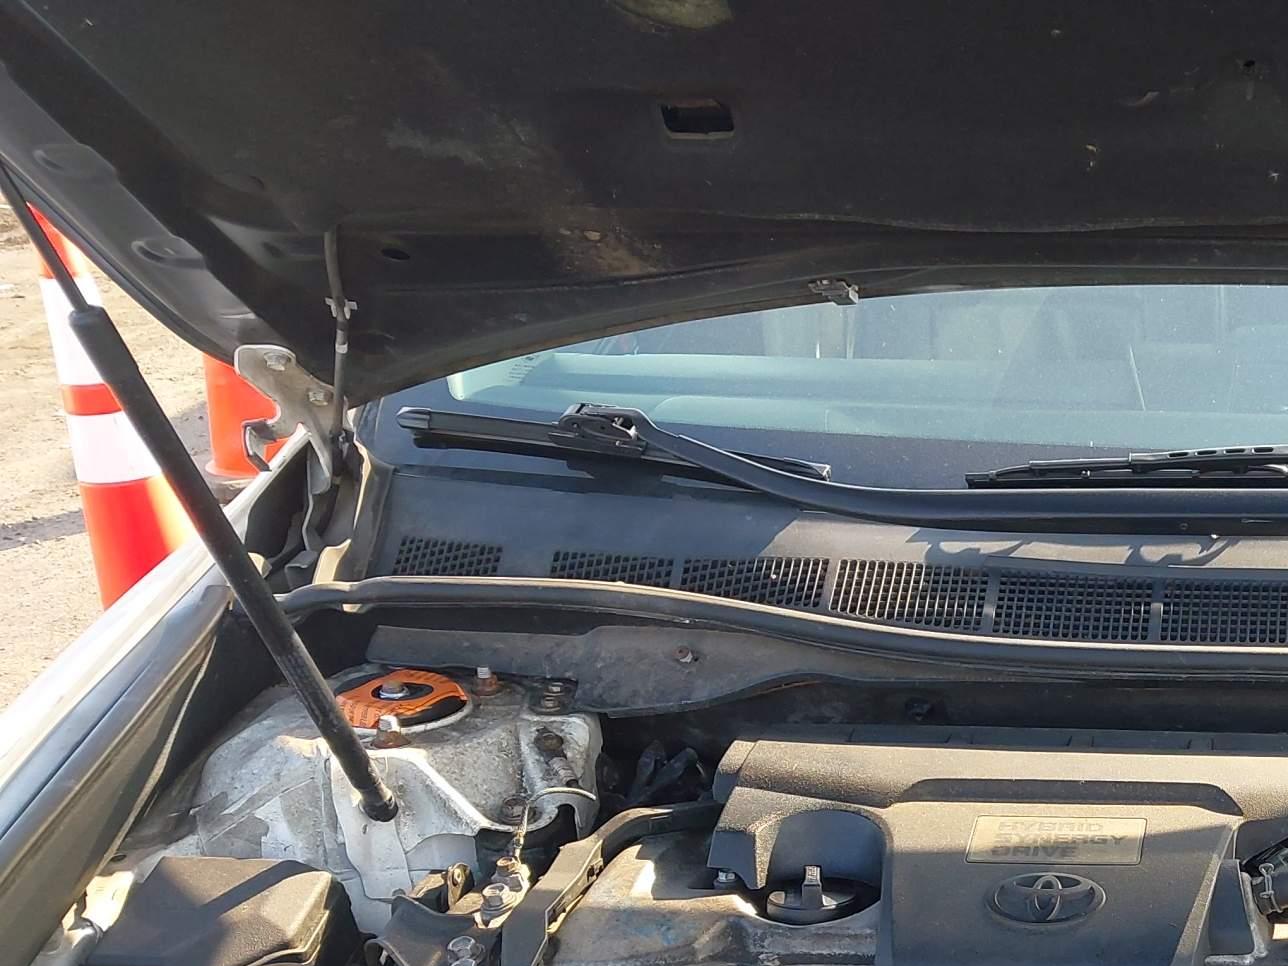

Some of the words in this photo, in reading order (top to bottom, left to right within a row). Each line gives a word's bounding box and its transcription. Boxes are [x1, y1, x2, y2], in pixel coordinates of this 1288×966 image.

[998, 822, 1104, 832] HYBRID
[993, 834, 1129, 845] SYNERGY
[991, 845, 1080, 857] DRIVE
